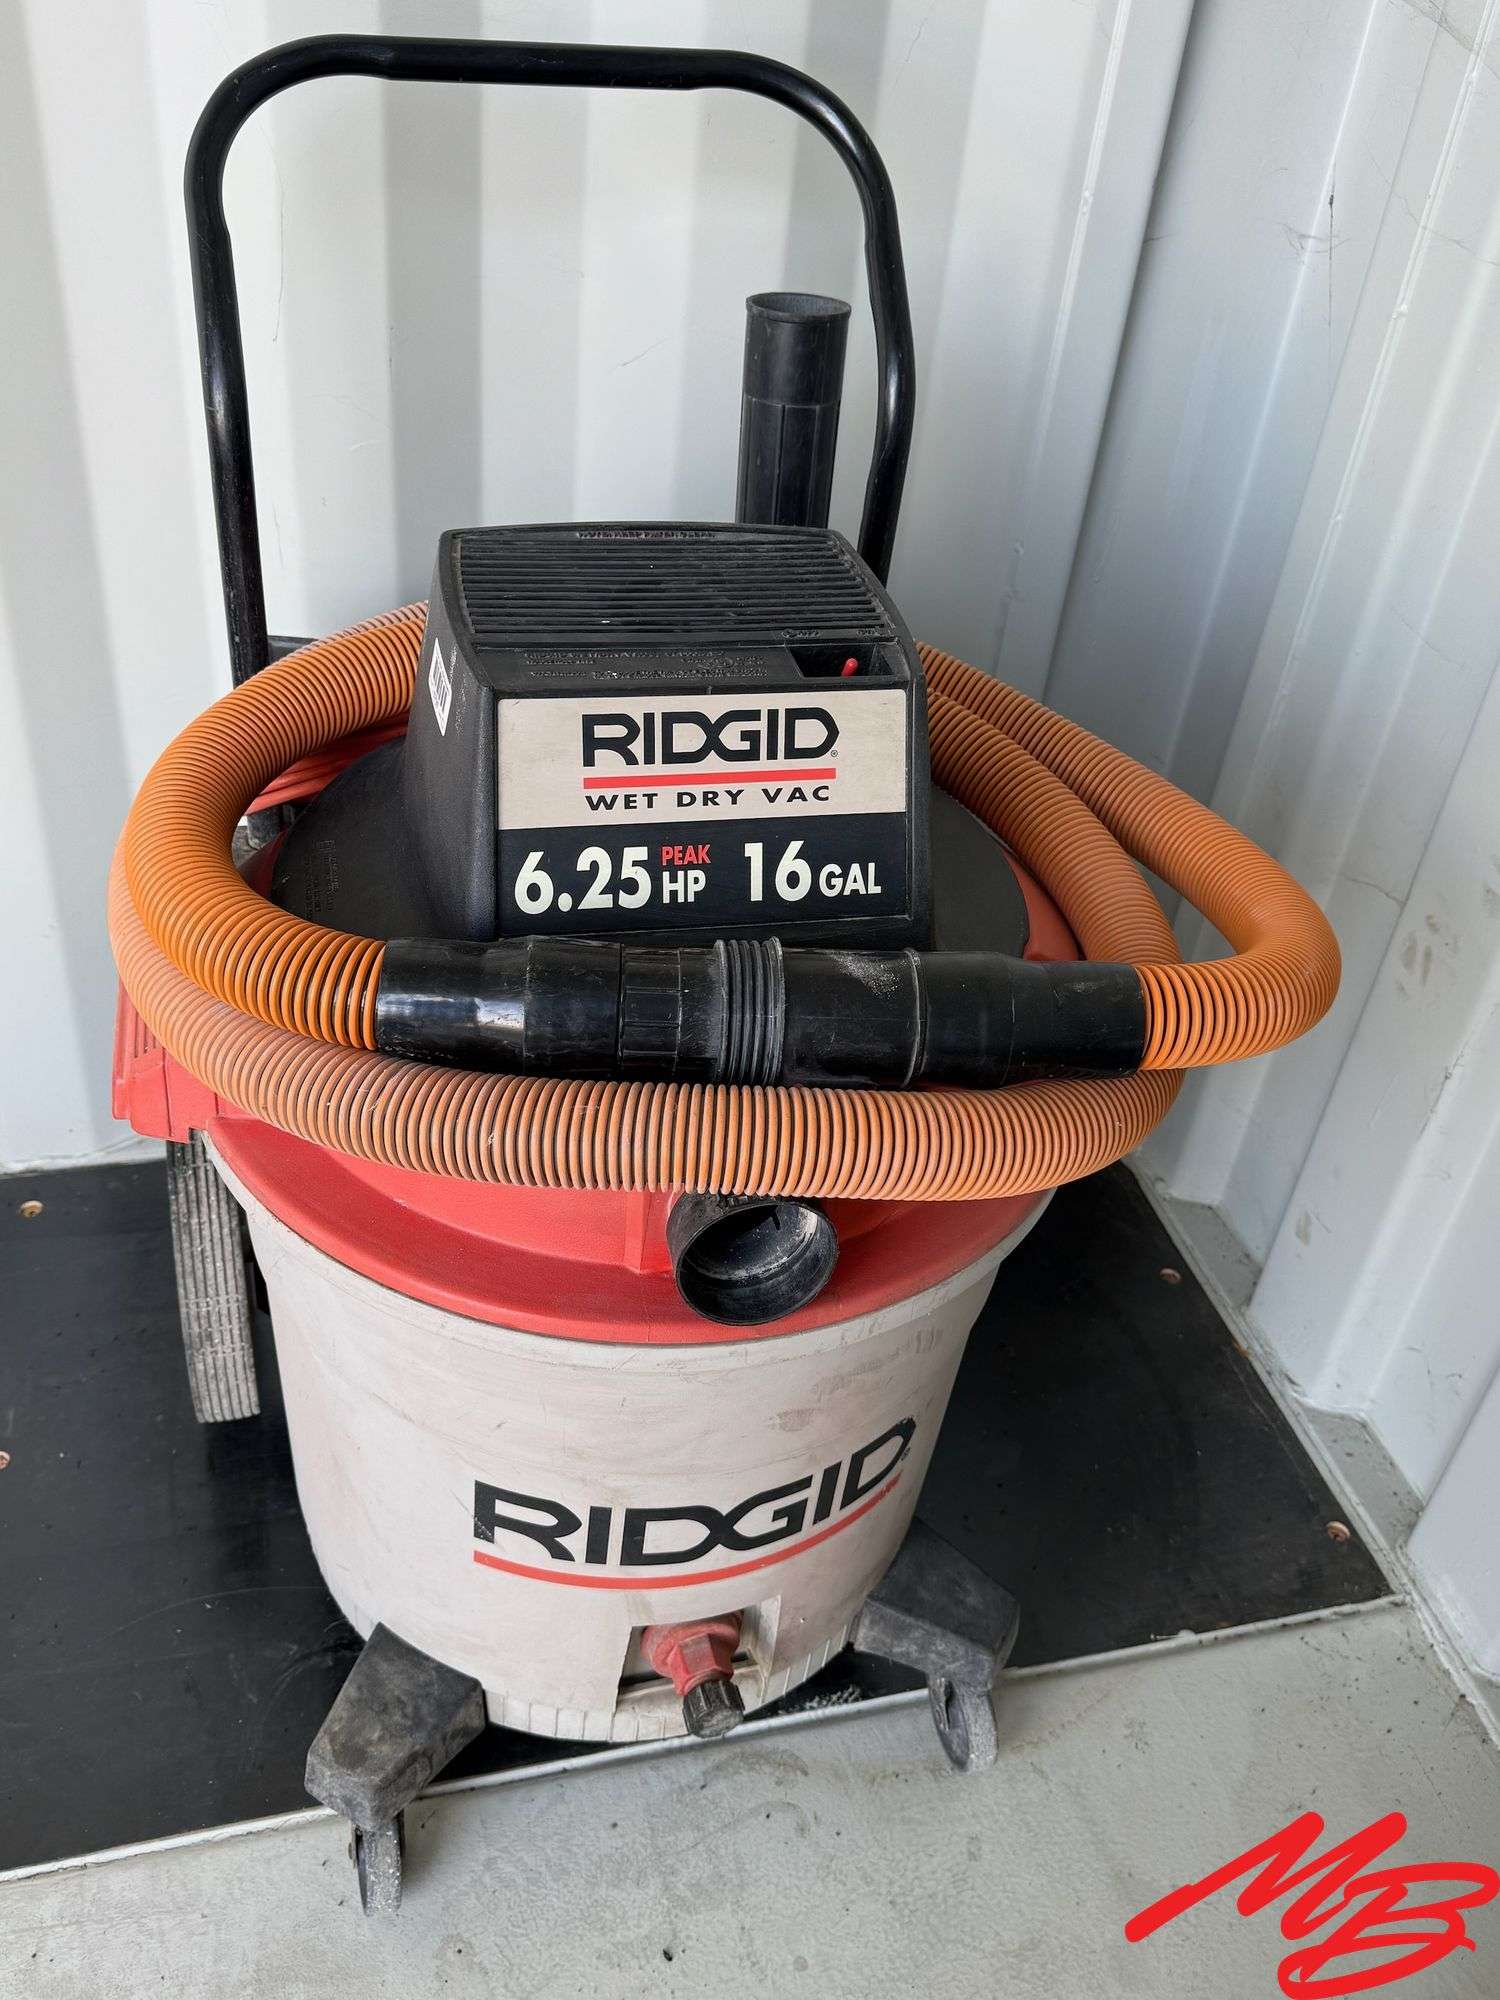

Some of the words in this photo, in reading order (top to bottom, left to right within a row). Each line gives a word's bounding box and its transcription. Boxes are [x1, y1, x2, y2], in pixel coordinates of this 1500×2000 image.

[582, 707, 840, 767] RIDGID
[586, 792, 658, 812] WET
[676, 788, 744, 808] DRY
[762, 785, 831, 804] VAC
[514, 846, 652, 915] 6.25
[661, 870, 706, 904] HP
[744, 840, 812, 902] 16
[819, 863, 882, 896] GAL
[661, 844, 711, 866] PEAK
[474, 1416, 916, 1566] RIDGID
